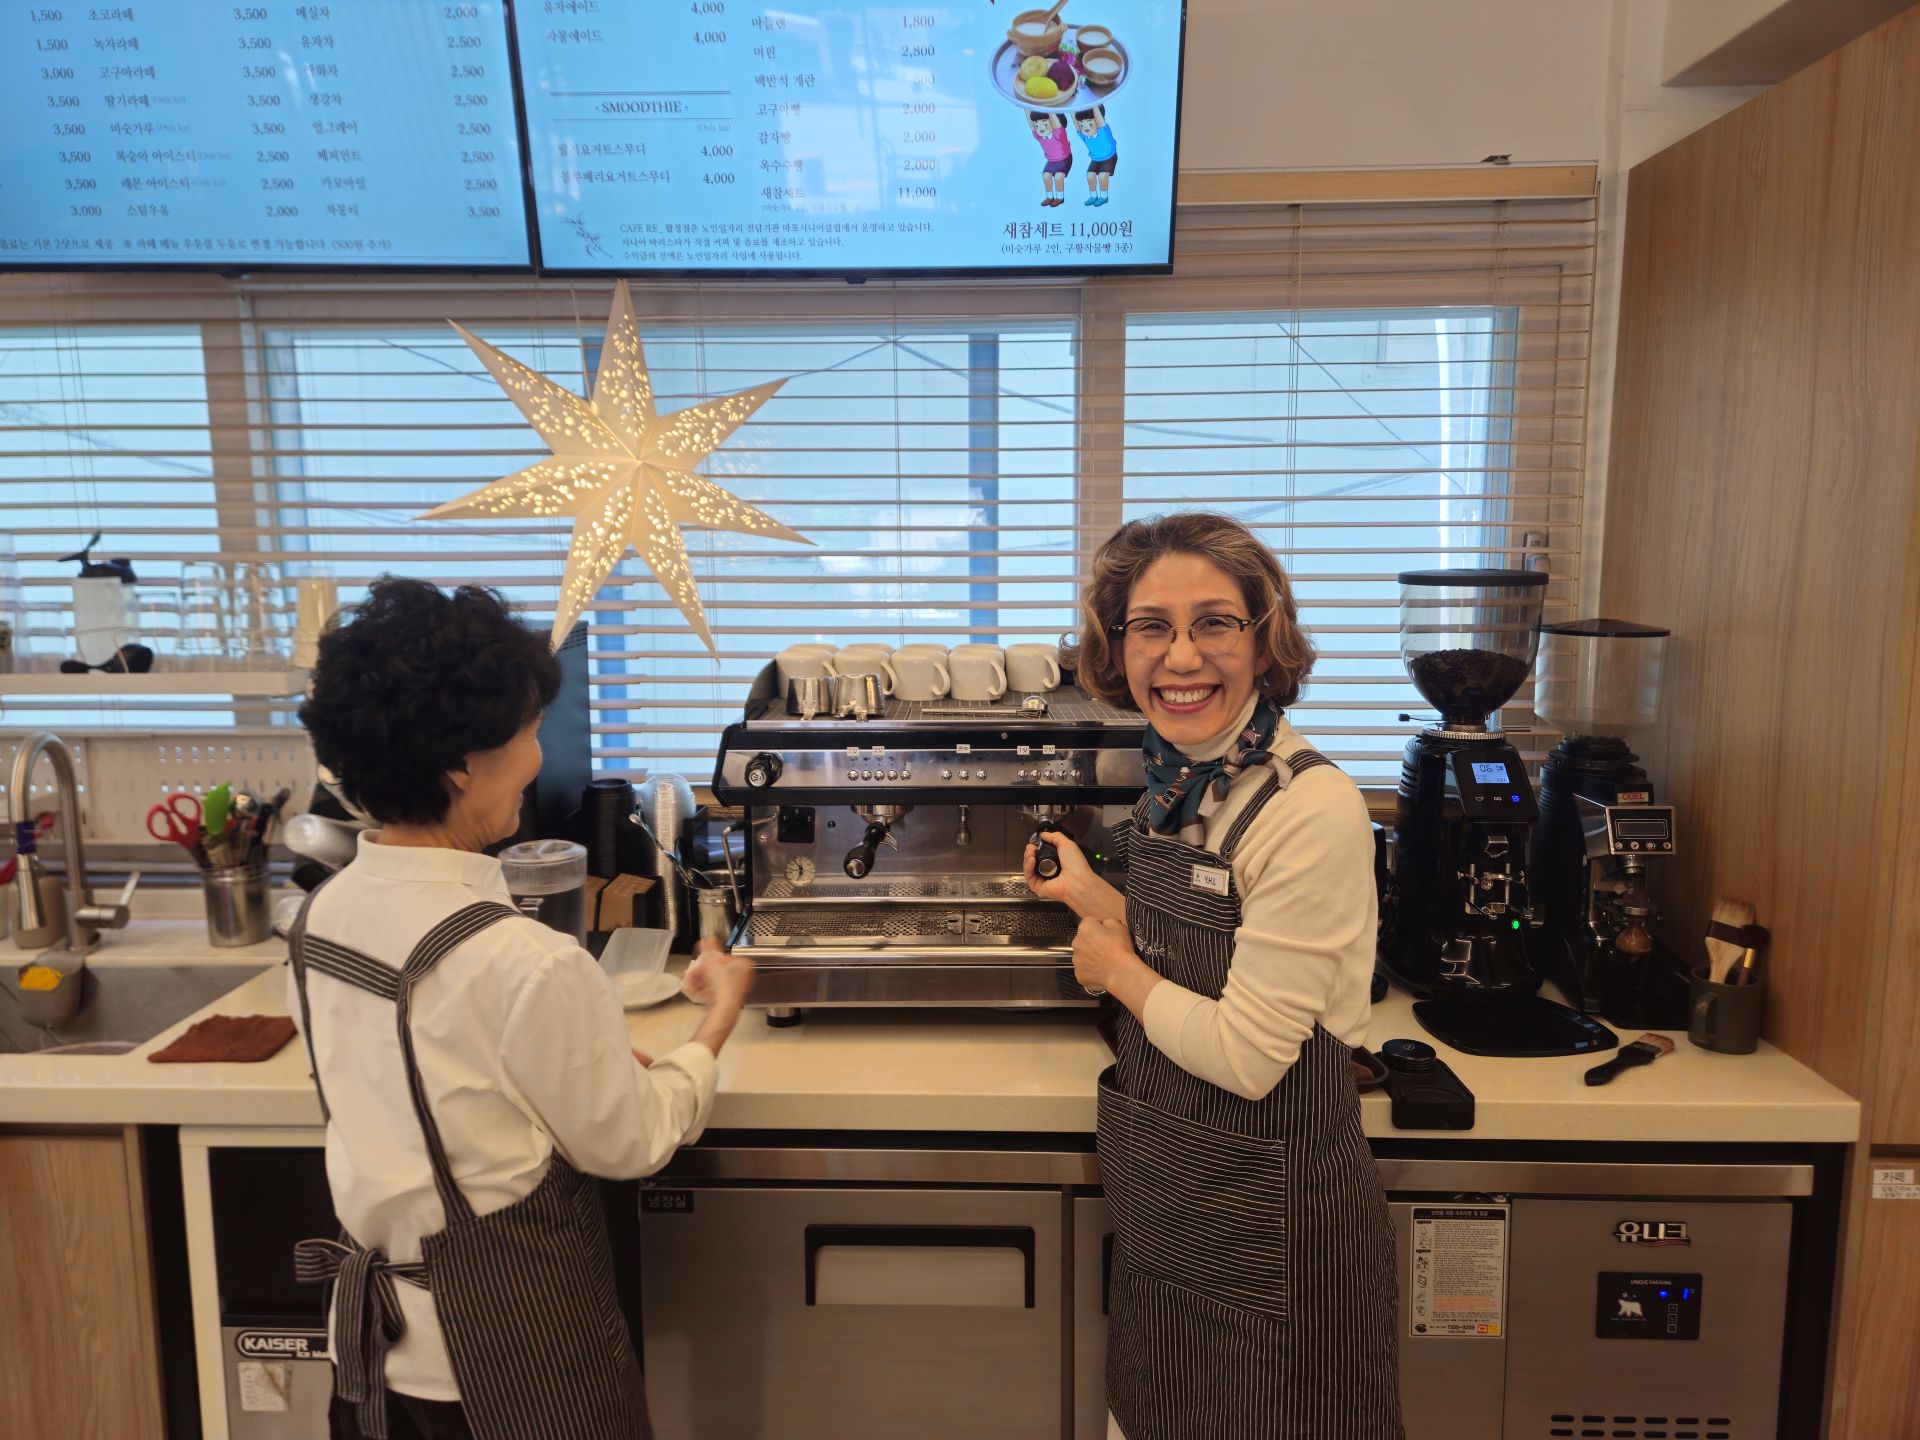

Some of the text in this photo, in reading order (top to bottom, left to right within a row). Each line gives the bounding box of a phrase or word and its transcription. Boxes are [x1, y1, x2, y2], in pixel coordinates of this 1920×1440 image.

[444, 7, 477, 19] 2,000
[691, 2, 725, 14] 4,000
[30, 10, 62, 22] 1,500
[88, 8, 267, 22] 초코라떼 3,500
[902, 15, 935, 28] 1,800
[448, 37, 481, 49] 2,500
[693, 31, 726, 44] 4,000
[36, 39, 68, 51] 1,500
[93, 37, 271, 51] 녹차라떼 3,500
[902, 45, 935, 58] 2,800
[41, 67, 74, 80] 3,000
[100, 66, 276, 79] 고구마라떼 3,500
[451, 66, 484, 78] 2,500
[47, 96, 80, 108] 3,500
[105, 95, 150, 108] 딸기라떼
[248, 95, 281, 107] 3,500
[455, 95, 488, 107] 2,500
[602, 101, 682, 114] SMOODTHIE
[756, 103, 935, 117] 고구마빵 2,000
[53, 124, 85, 136] 3,500
[110, 123, 155, 136] 미숫가루
[253, 123, 286, 135] 3,500
[458, 123, 491, 135] 2,500
[759, 131, 936, 144] 감자빵 2,000
[59, 151, 91, 164] 3,500
[116, 150, 149, 164] 복숭아
[152, 150, 196, 164] 아이스티
[257, 151, 289, 163] 2,500
[461, 151, 494, 163] 2,500
[701, 146, 733, 158] 4,000
[904, 160, 936, 172] 2,000
[64, 179, 96, 191] 3,500
[147, 177, 190, 190] 아이스티
[261, 178, 294, 190] 2,500
[464, 179, 497, 191] 2,500
[703, 173, 735, 185] 4,000
[762, 187, 936, 200] 새참세트 11,000
[70, 206, 102, 218] 3,000
[266, 206, 299, 217] 2,000
[467, 206, 500, 218] 3,500
[620, 224, 643, 233] CAFE
[898, 223, 934, 232] 있습니다.
[1002, 220, 1133, 239] 새참세트 11,000원
[808, 236, 844, 246] 있습니다.
[1001, 244, 1042, 254] (미숫가루
[1045, 244, 1062, 254] 2인,
[1115, 243, 1133, 253] 3종)
[647, 1191, 687, 1208] 냉장실
[1615, 1221, 1690, 1243] 유니크
[244, 1336, 309, 1351] KAISER
